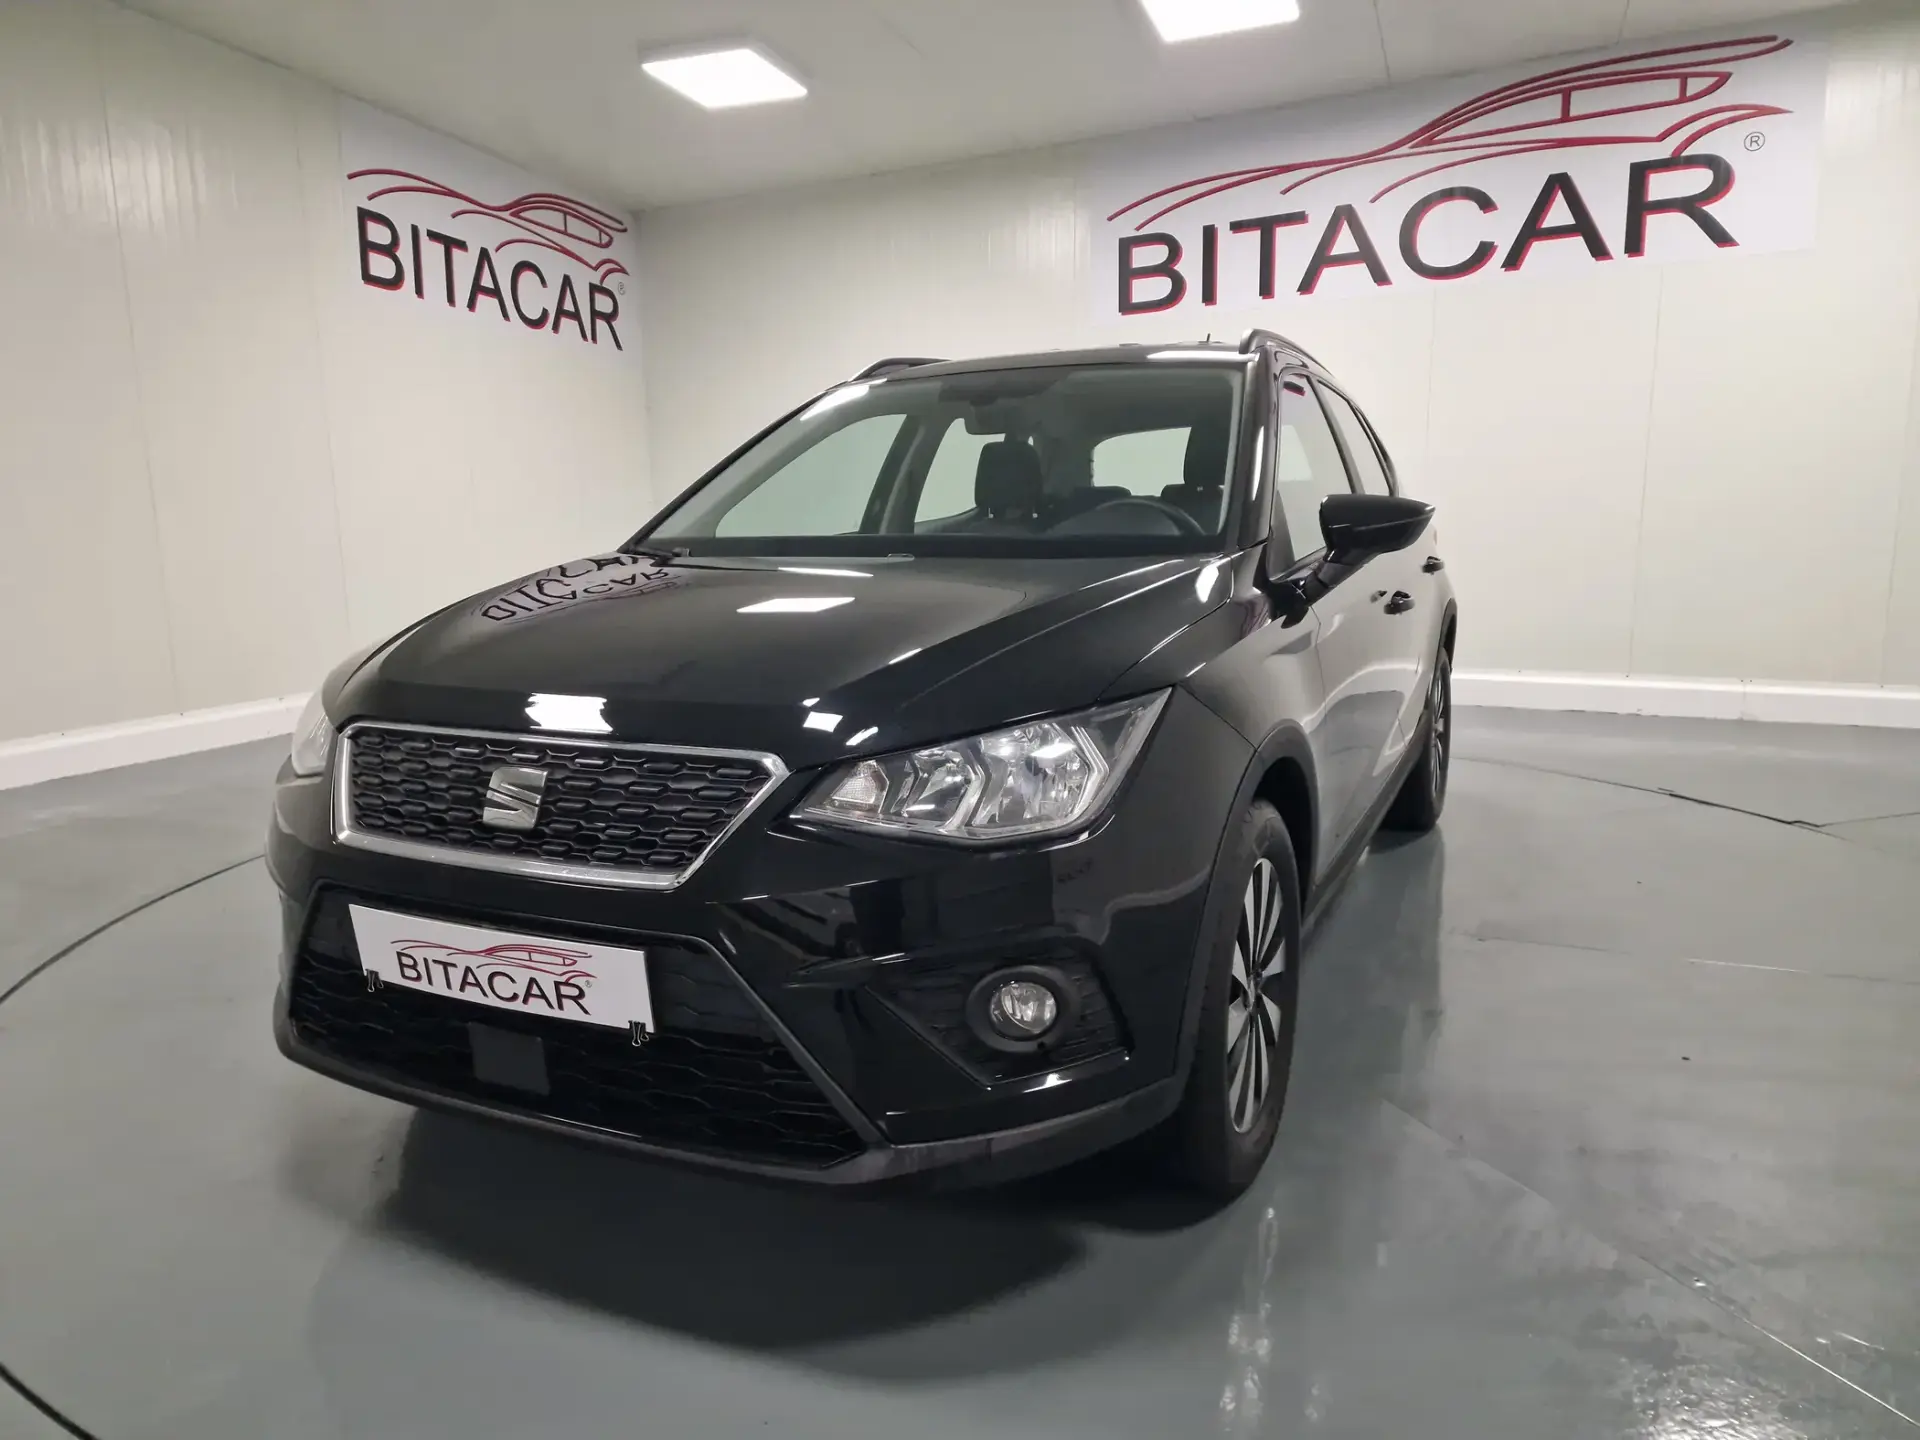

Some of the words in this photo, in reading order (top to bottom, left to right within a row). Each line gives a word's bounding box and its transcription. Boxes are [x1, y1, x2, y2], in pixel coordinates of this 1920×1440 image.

[356, 206, 624, 351] BITACAR
[1118, 153, 1740, 315] BITACAR
[396, 950, 592, 1016] BITACAR
